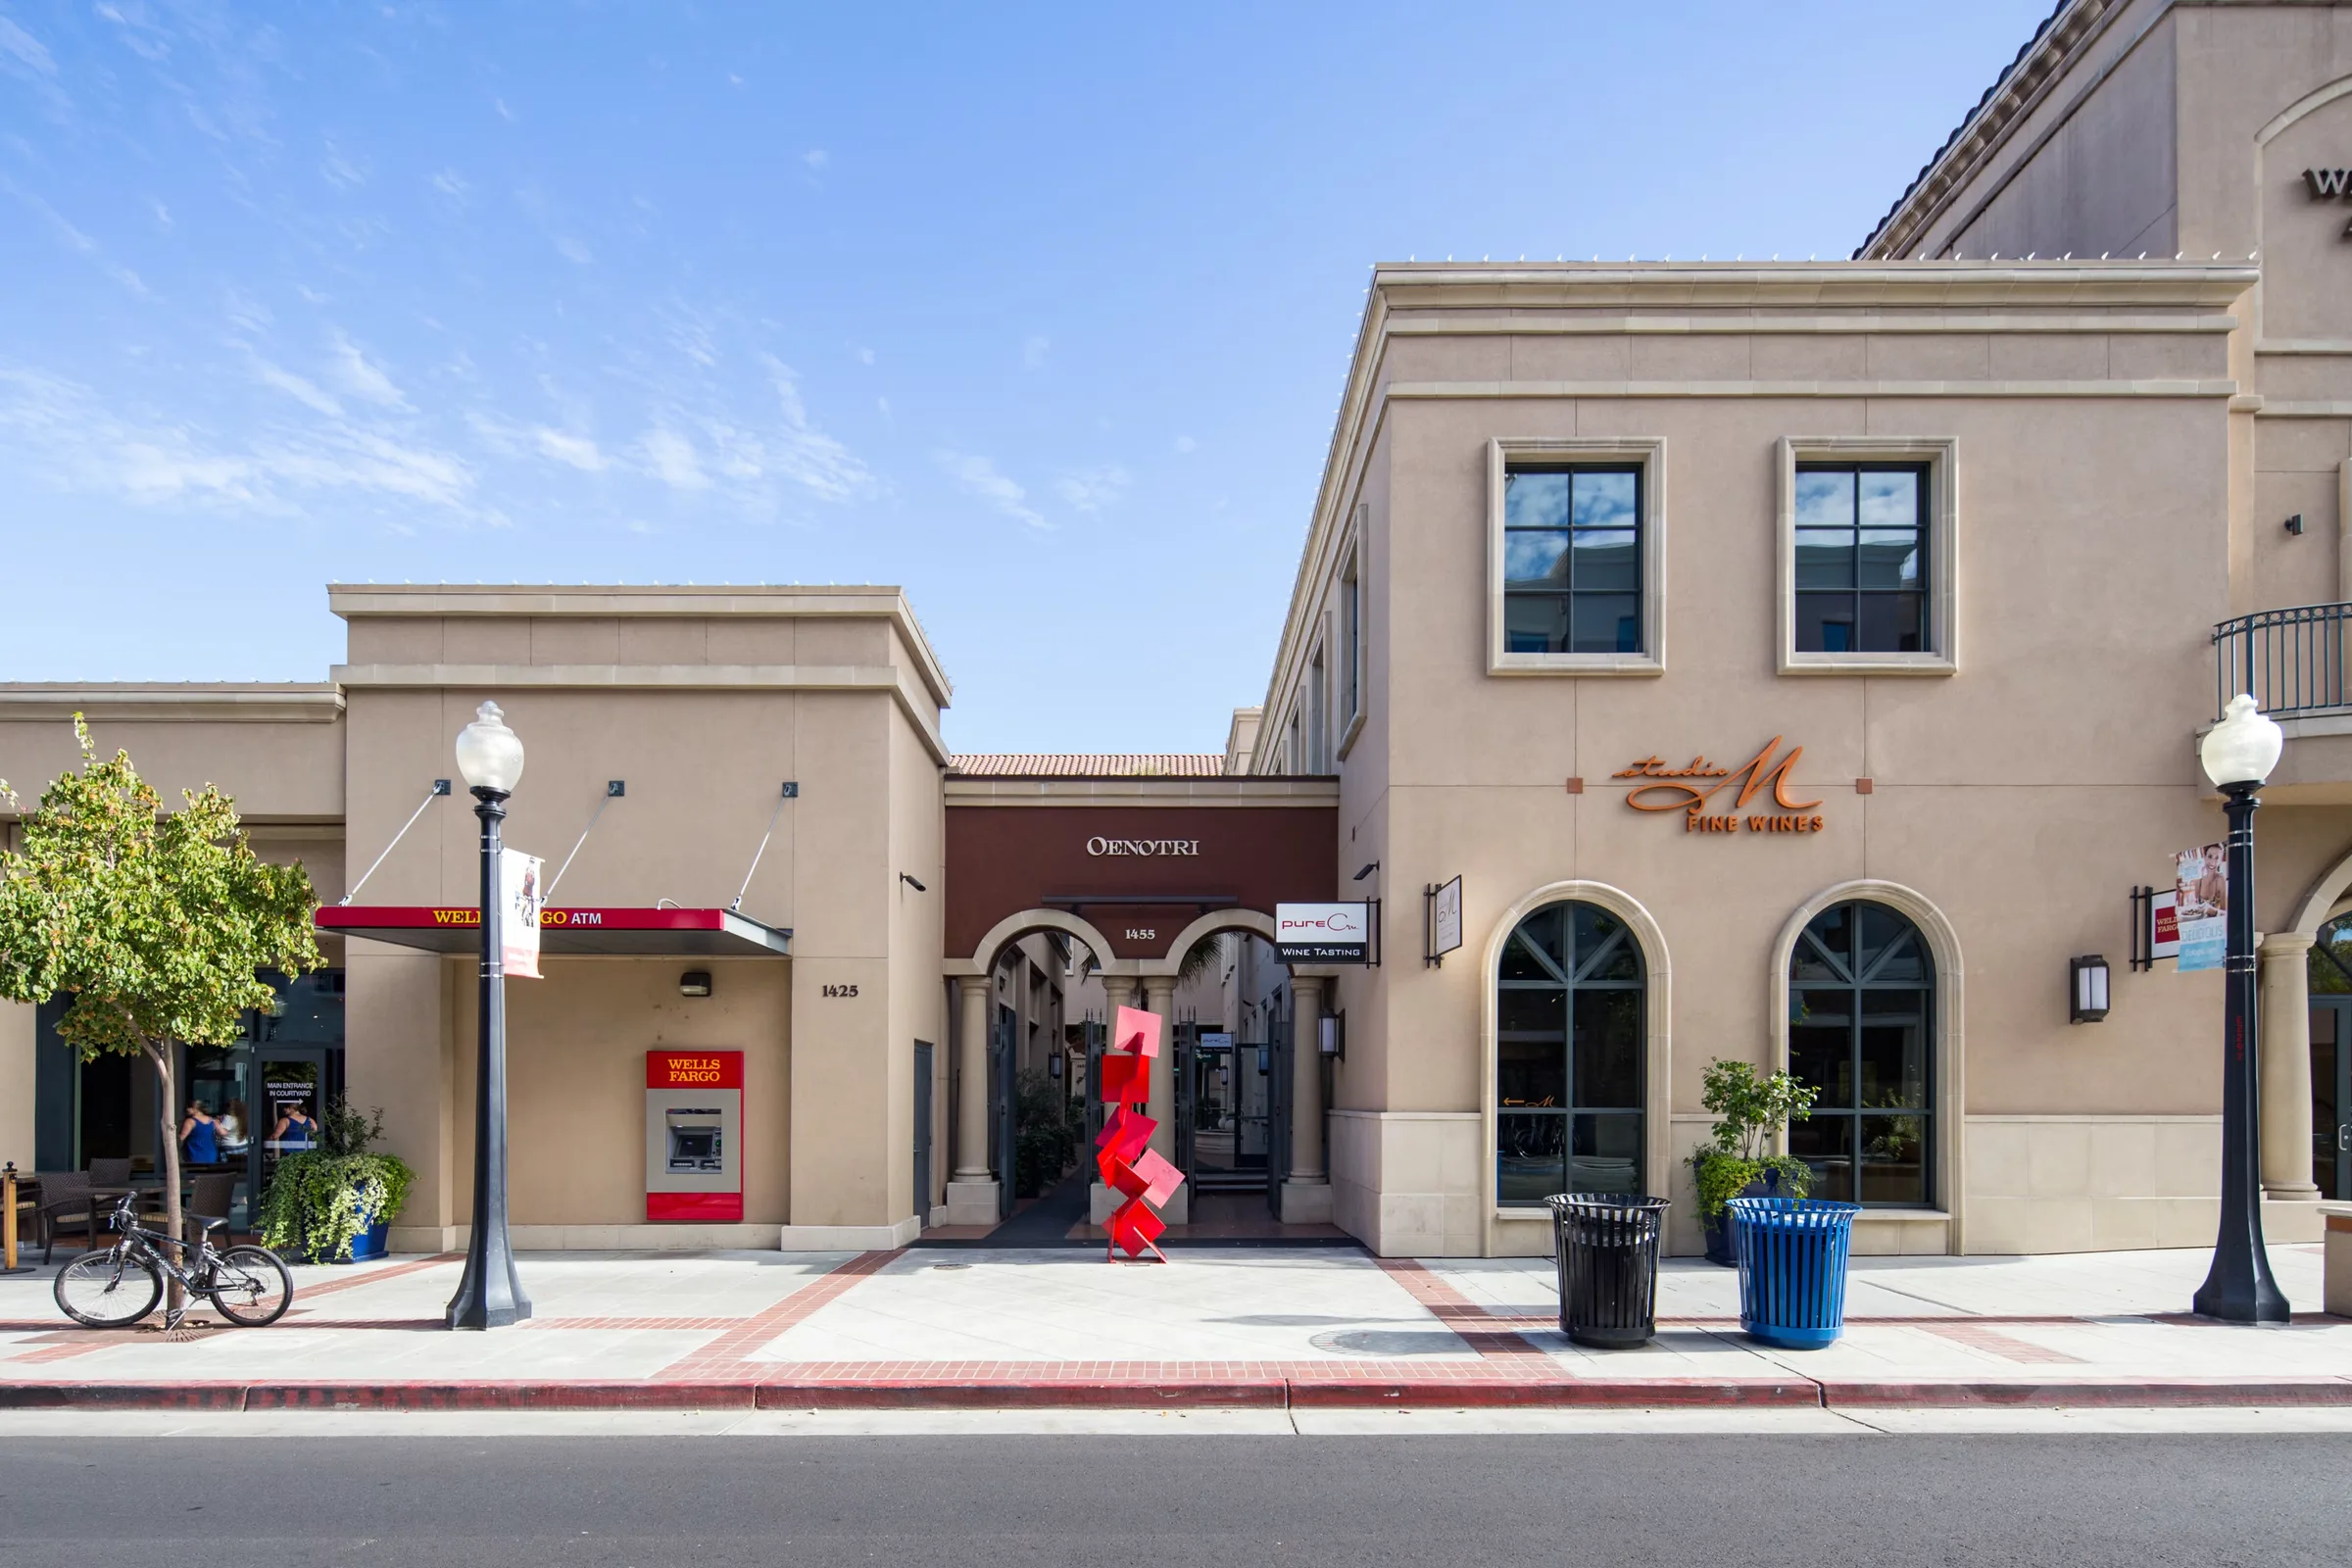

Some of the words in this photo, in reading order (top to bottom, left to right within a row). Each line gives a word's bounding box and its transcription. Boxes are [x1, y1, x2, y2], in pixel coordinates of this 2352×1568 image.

[2305, 167, 2352, 199] W
[1612, 755, 1730, 778] studio
[1626, 734, 1823, 815] M
[1687, 815, 1739, 832] FINE
[1748, 815, 1824, 832] WINES
[1086, 836, 1200, 857] OENOTRI
[570, 912, 602, 925] ATM
[1125, 928, 1155, 940] 1455
[1282, 948, 1310, 956] WINE
[1314, 948, 1360, 956] TASTING
[822, 984, 858, 998] 1425
[667, 1058, 720, 1070] WELLS
[669, 1070, 720, 1082] FARGO
